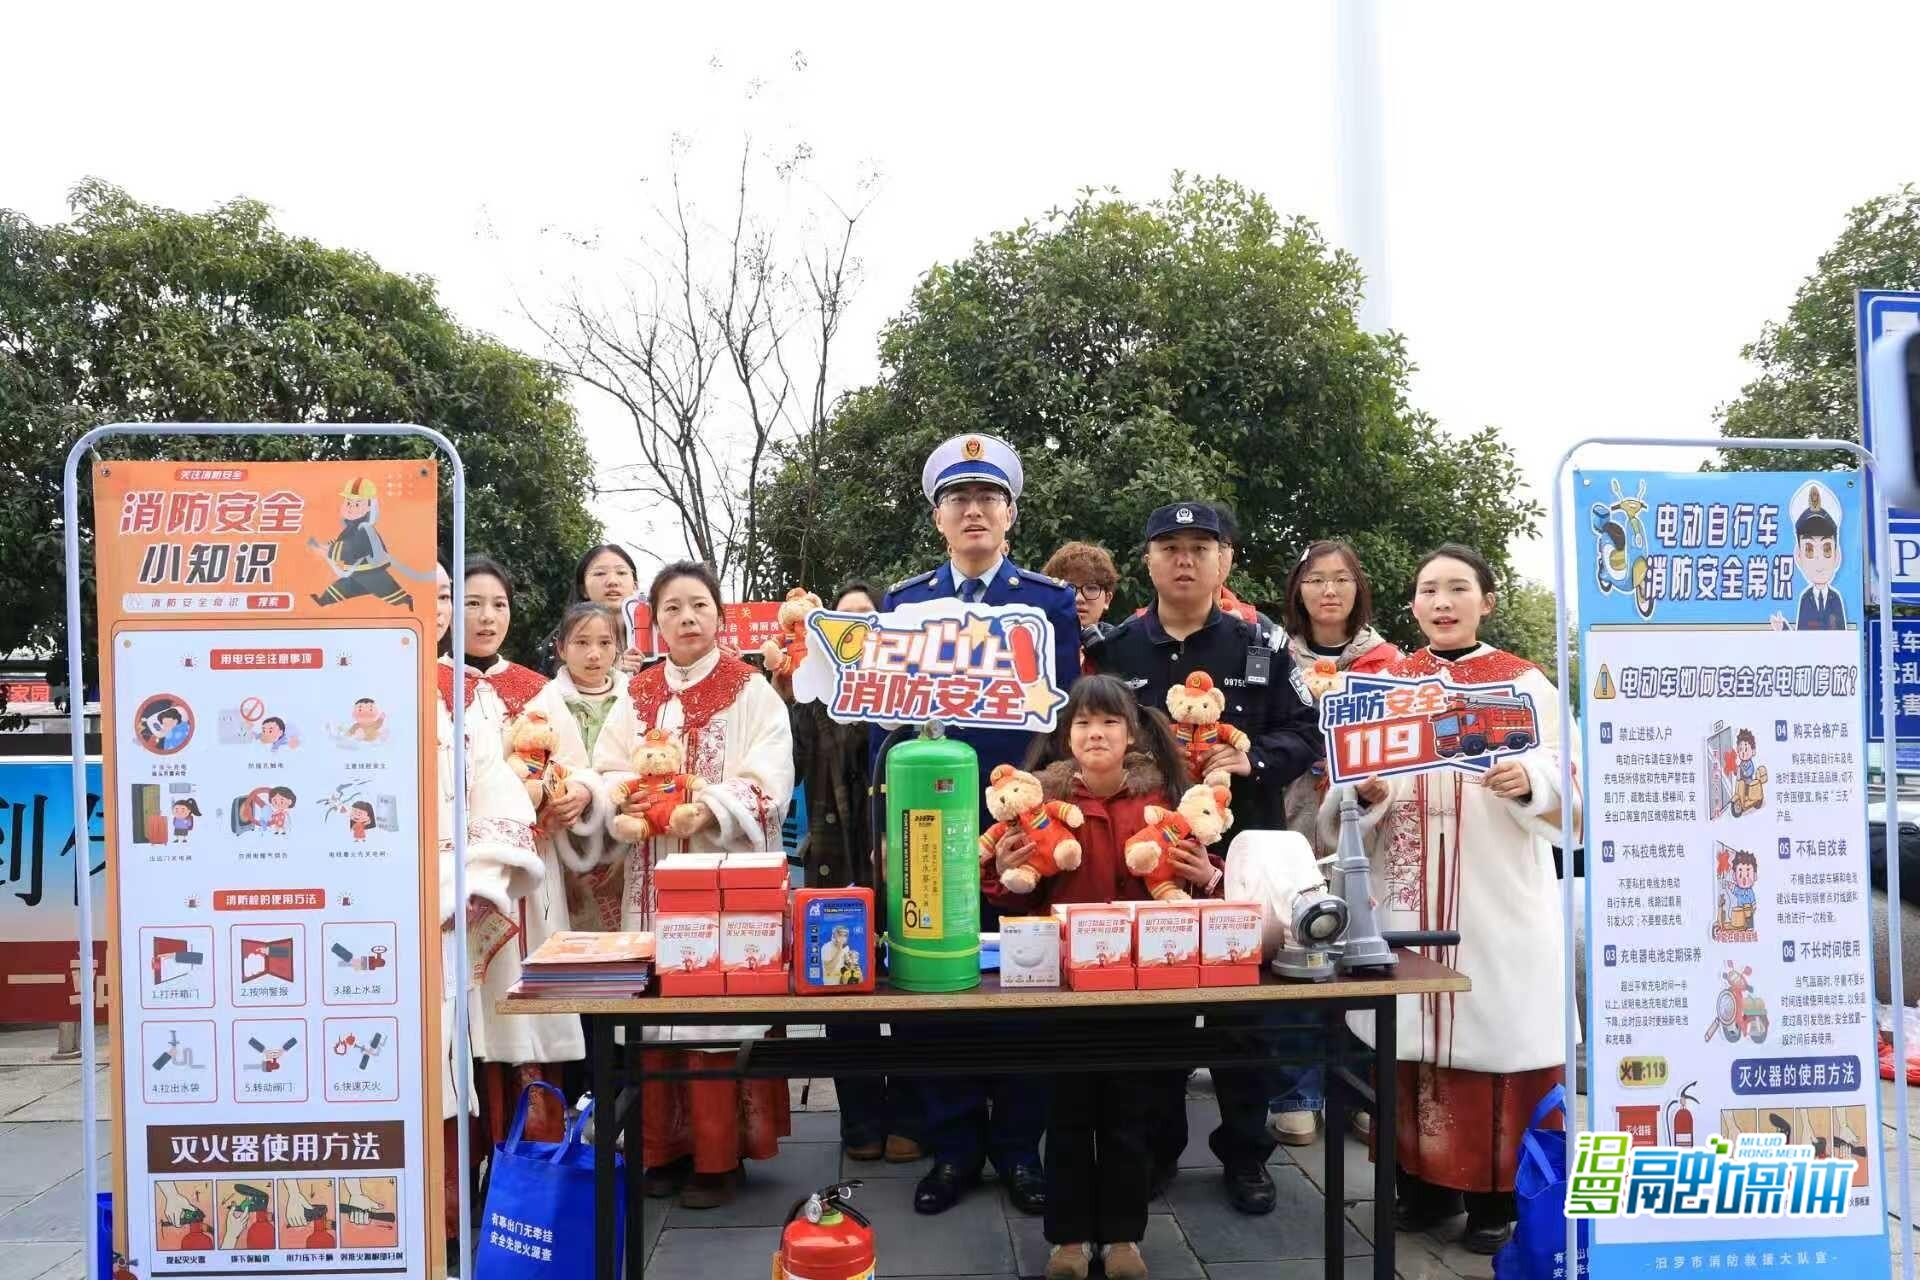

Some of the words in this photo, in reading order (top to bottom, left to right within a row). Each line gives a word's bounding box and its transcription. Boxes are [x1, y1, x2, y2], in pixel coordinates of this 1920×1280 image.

[119, 491, 304, 536] 消防安全
[1655, 503, 1779, 548] 电动自行车
[138, 543, 278, 585] 小知识
[1894, 539, 1920, 577] P
[1645, 555, 1794, 600] 消防安全常识
[220, 653, 313, 666] 用电安全注意事项
[836, 669, 1026, 721] 消防安全
[1620, 665, 1857, 698] 电动车如何安全充电和停放?
[1327, 683, 1447, 726] 消防安全
[1601, 727, 1611, 739] 01
[1776, 724, 1786, 737] 04
[1793, 722, 1848, 739] 购买合格产品
[1343, 721, 1421, 769] 119
[1622, 844, 1685, 859] 不私拉电线充电
[1780, 842, 1789, 854] 05
[1795, 839, 1848, 857] 不私自改装
[226, 894, 317, 906] 消防栓的使用方法
[905, 900, 933, 929] 6L
[1620, 947, 1702, 963] 充电器电池定期保养
[1784, 944, 1793, 957] 06
[1800, 940, 1860, 959] 不长时间使用
[151, 989, 200, 1001] 1.打开箱门
[240, 986, 289, 998] 2.按响警报
[151, 1082, 200, 1094] 4.拉出水袋
[333, 1081, 382, 1093] 6.快速灭火
[1738, 1061, 1855, 1089] 灭火器的使用方法
[171, 1131, 380, 1164] 灭火器使用方法
[491, 1212, 553, 1244] 有事出门无牵挂
[489, 1231, 552, 1262] 安全先把火源查
[1655, 1251, 1829, 1270] 汨罗市消防救援大队宣
